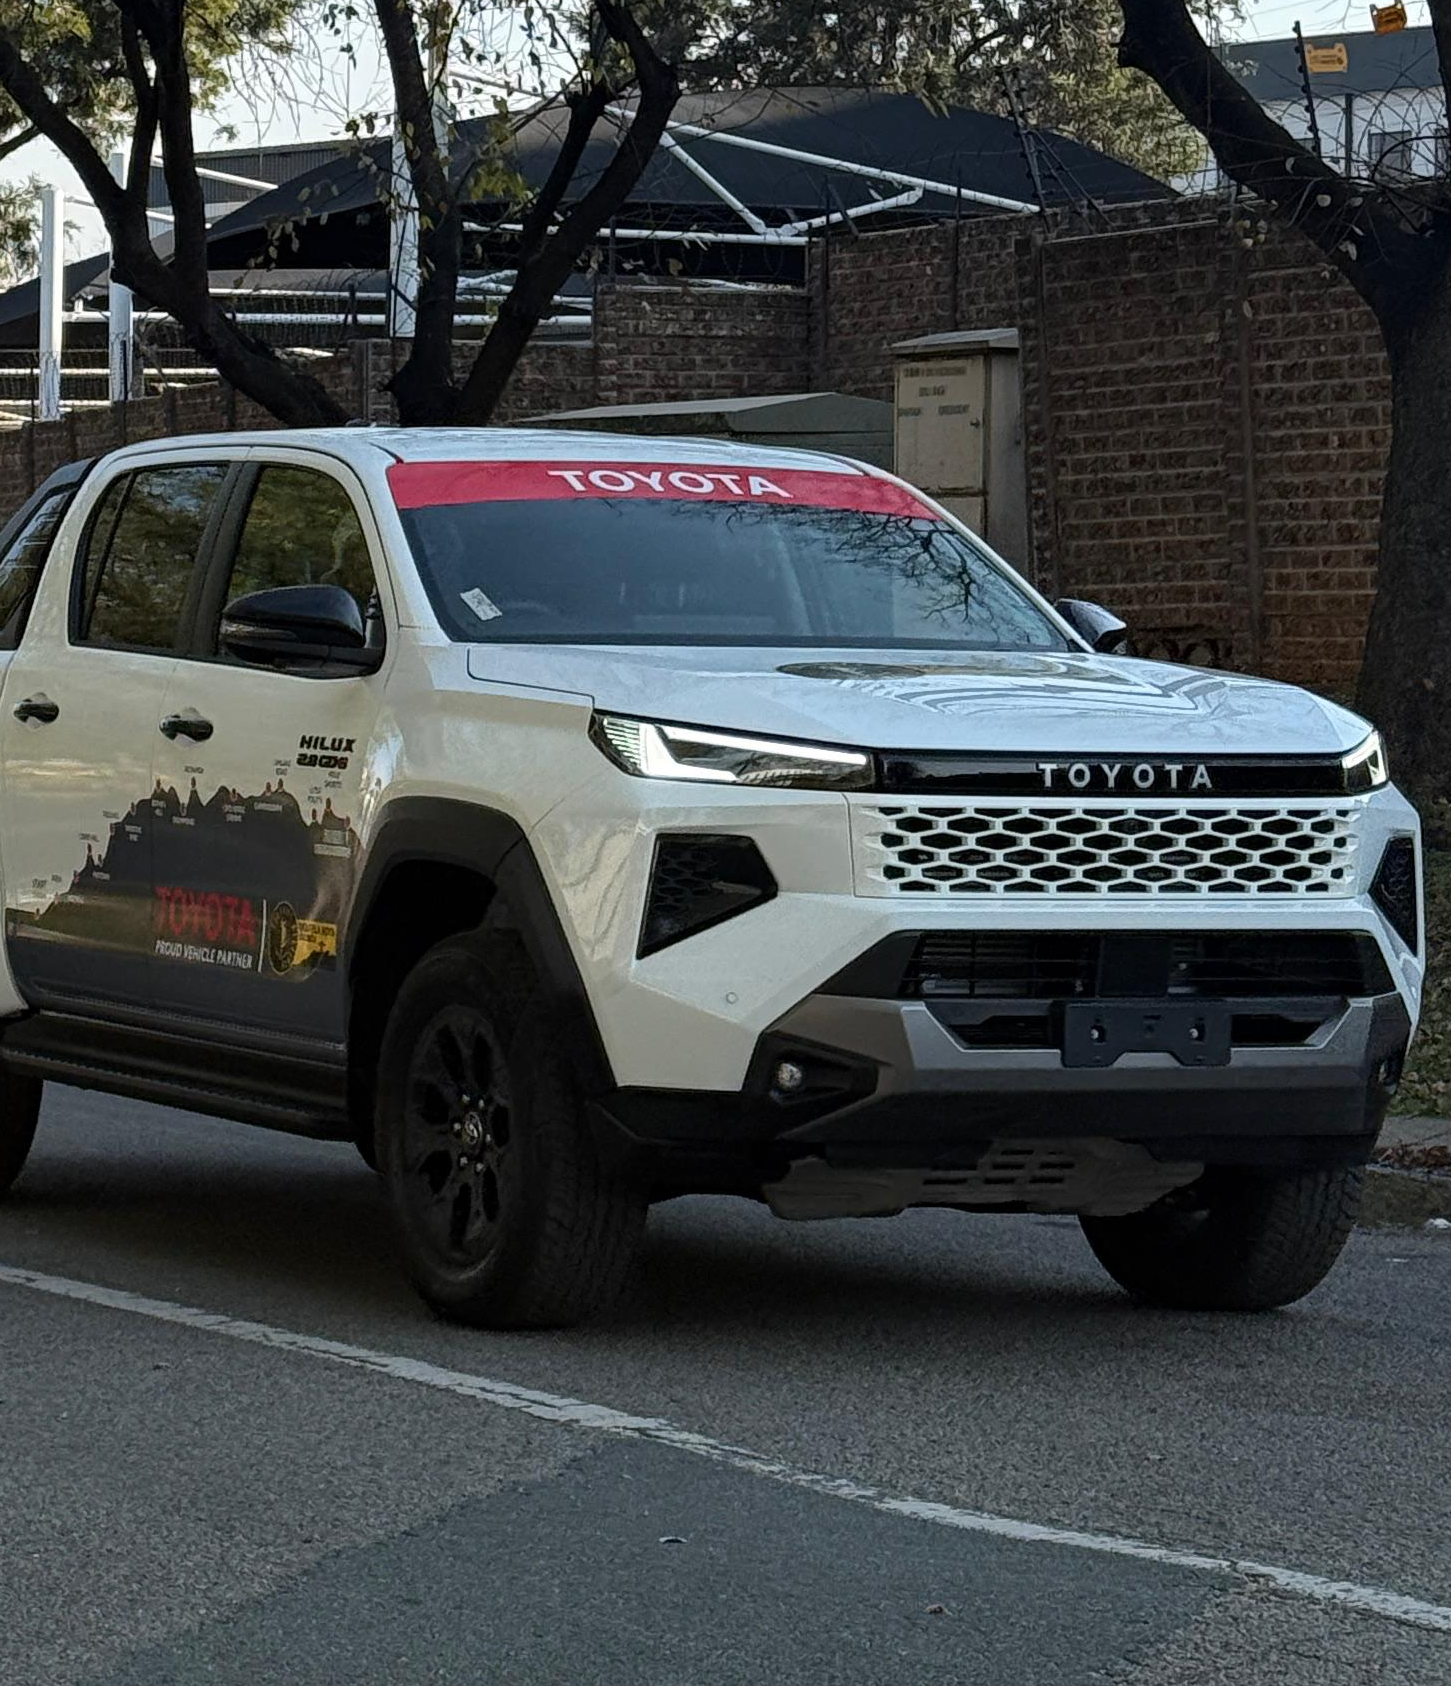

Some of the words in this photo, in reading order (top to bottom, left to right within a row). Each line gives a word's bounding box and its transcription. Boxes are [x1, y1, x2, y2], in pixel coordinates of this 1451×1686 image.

[546, 470, 793, 498] TOYOTA
[299, 735, 356, 753] HILUX
[1038, 763, 1213, 789] TOYOTA
[155, 886, 256, 946] TOYOTA
[155, 939, 182, 958] PROUD
[183, 942, 216, 963] VEHICLE
[216, 949, 253, 969] PARTNER
